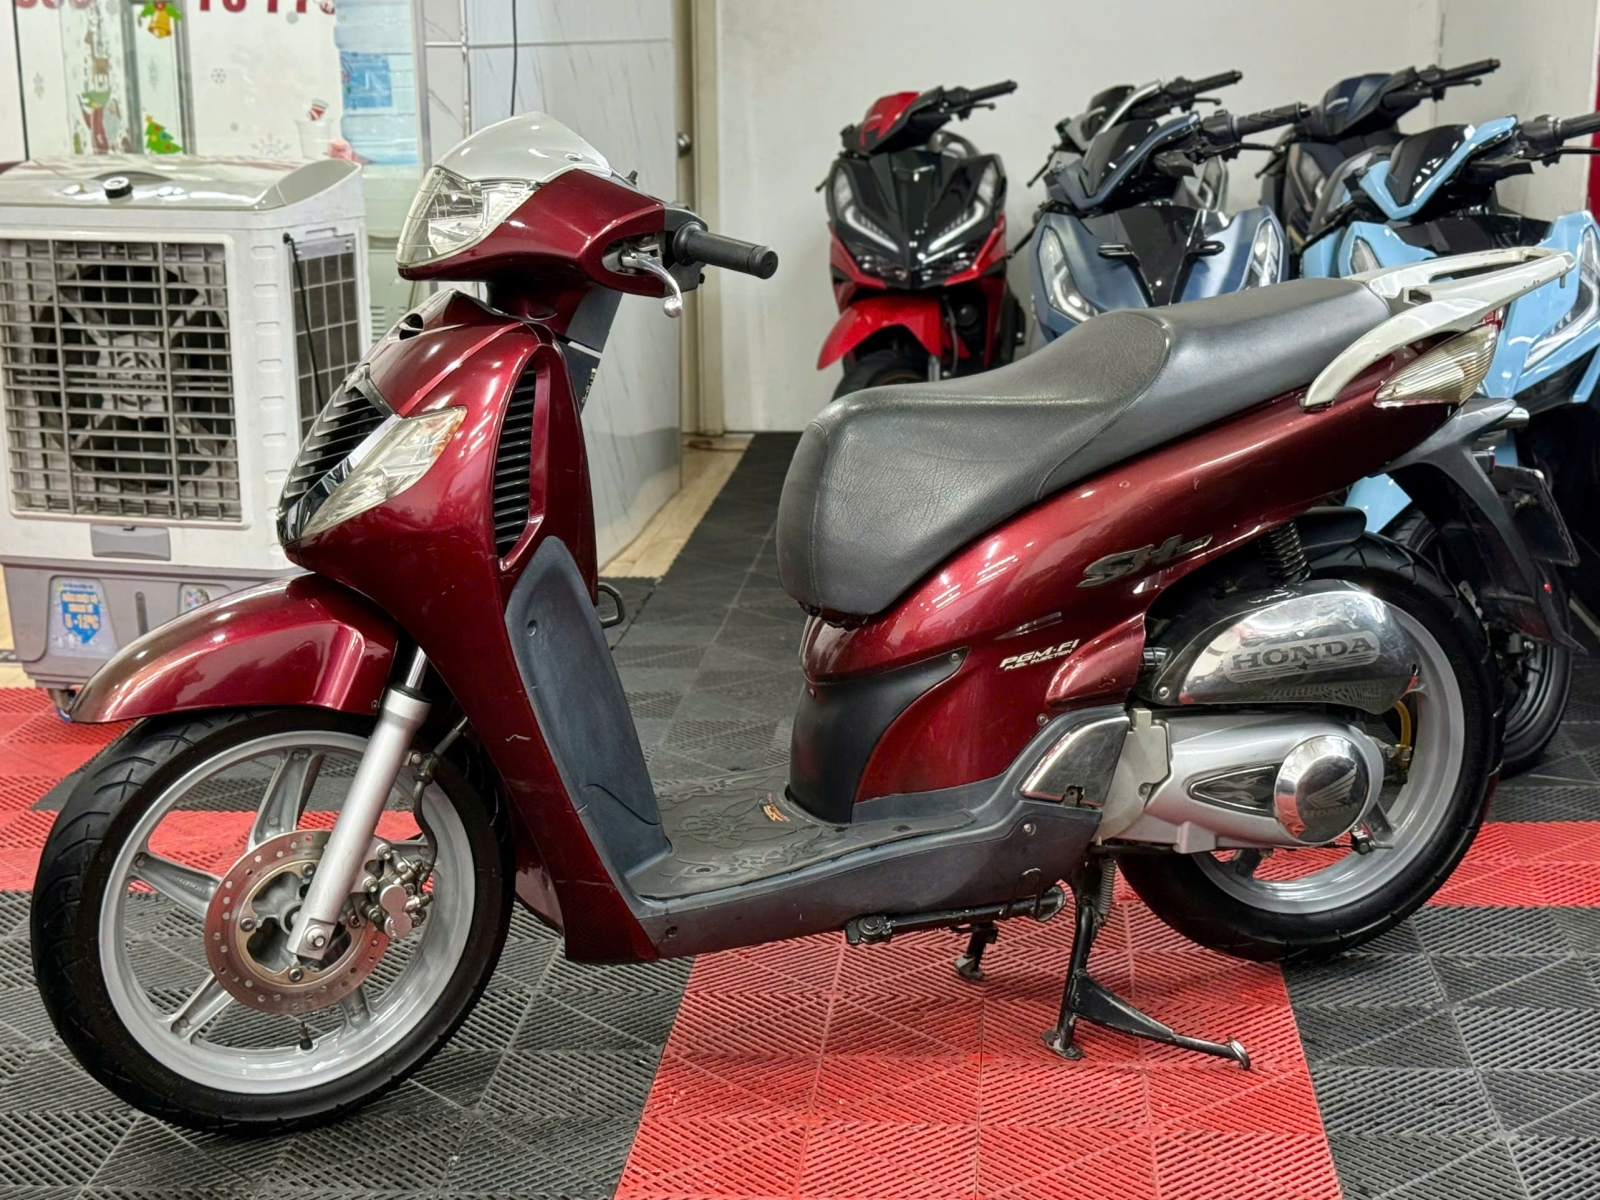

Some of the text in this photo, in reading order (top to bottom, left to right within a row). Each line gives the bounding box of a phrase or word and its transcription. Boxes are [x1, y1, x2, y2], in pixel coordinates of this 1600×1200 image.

[999, 638, 1080, 668] PGM-FI
[1004, 649, 1073, 671] FUEL INJECTION
[1230, 637, 1376, 671] HONDA
